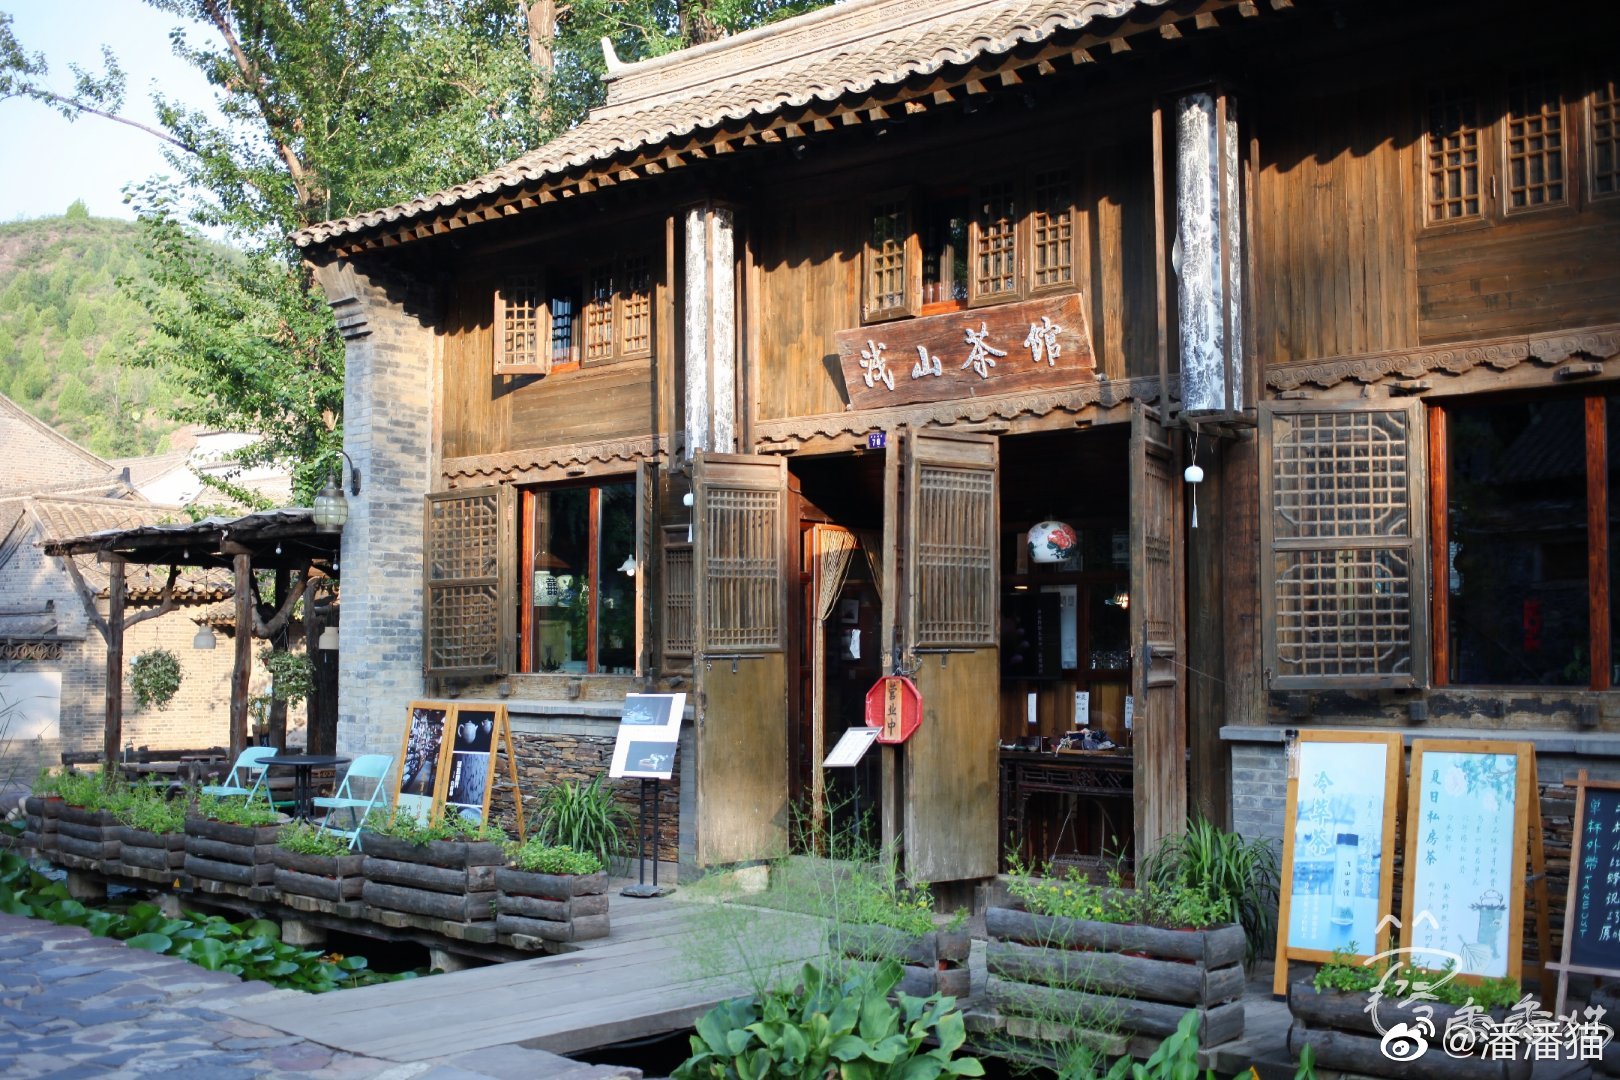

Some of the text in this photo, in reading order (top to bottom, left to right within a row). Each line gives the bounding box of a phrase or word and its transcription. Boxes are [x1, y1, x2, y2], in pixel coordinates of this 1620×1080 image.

[887, 681, 898, 737] 营业中
[1308, 770, 1334, 856] 冷萃茶
[1424, 768, 1442, 866] 夏日私房茶
